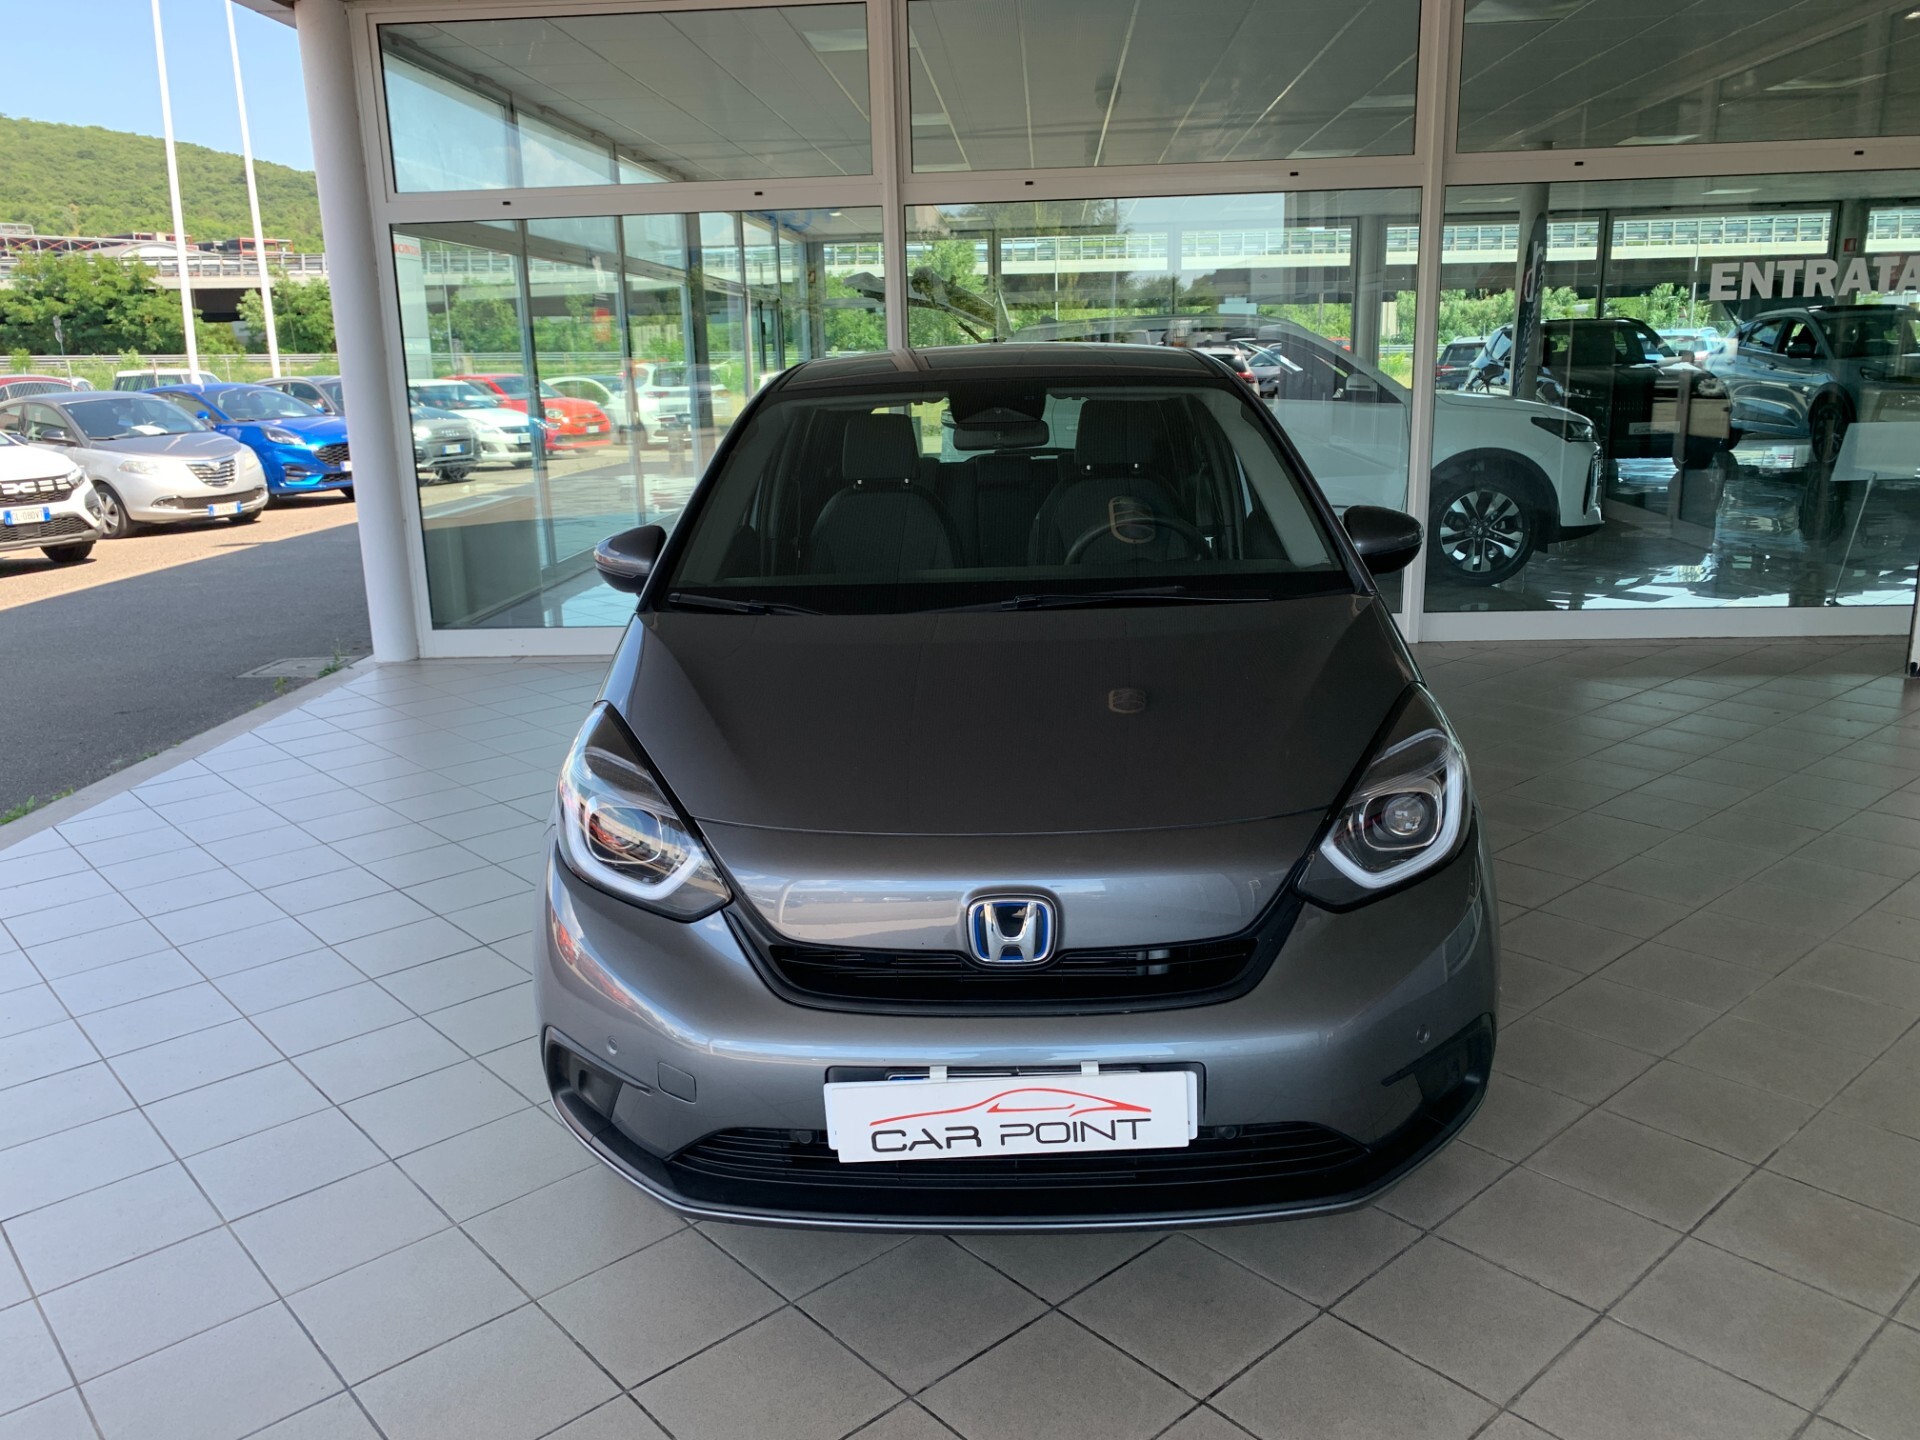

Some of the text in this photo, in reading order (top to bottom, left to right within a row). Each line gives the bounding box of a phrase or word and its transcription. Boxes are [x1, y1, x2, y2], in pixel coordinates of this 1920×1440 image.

[1709, 255, 1920, 301] ENTRATA
[870, 1118, 1152, 1153] CAR POINT
